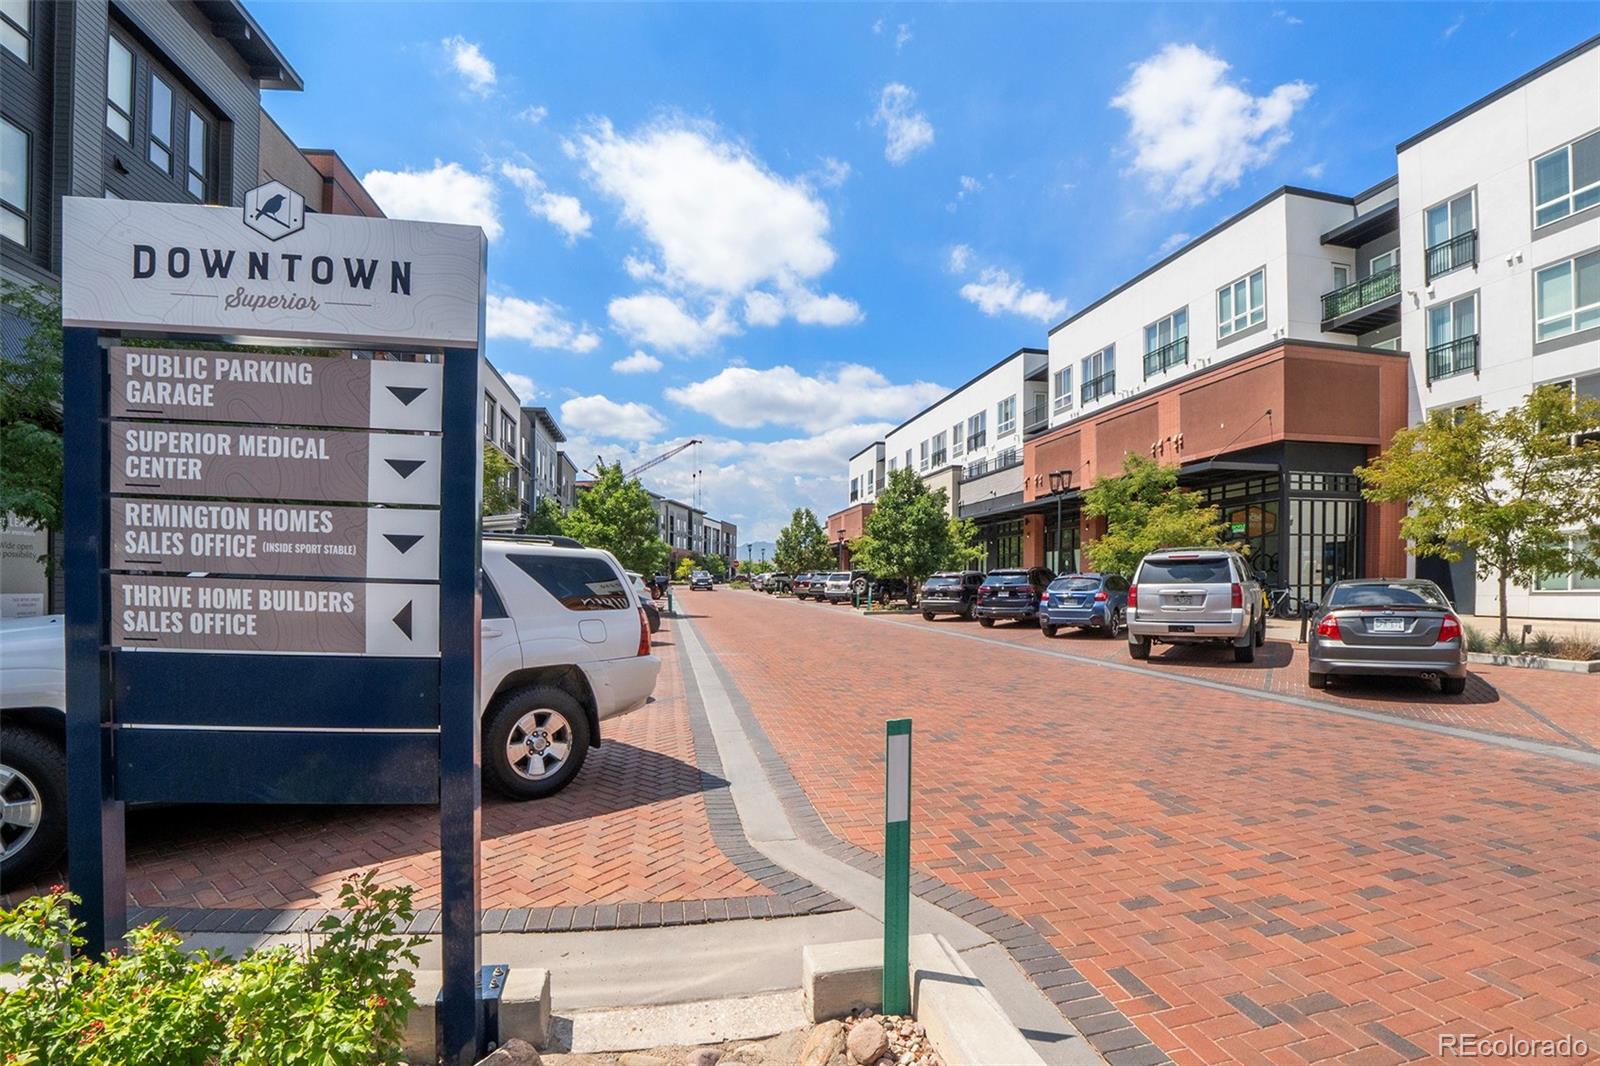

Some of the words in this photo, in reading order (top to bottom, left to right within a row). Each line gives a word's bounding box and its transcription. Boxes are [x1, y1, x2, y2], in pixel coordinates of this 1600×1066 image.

[132, 244, 412, 296] DOWNTOWN
[224, 286, 321, 312] Superior
[125, 352, 208, 381] PUBLIC
[215, 358, 313, 385] PARKING
[125, 380, 214, 407] GARAGE
[125, 430, 231, 455] SUPERIOR
[239, 434, 329, 460] MEDICAL
[125, 456, 202, 480] CENTER
[125, 503, 249, 530] REMINGTON
[257, 508, 333, 533] HOMES
[124, 531, 184, 556] SALES
[190, 533, 257, 558] OFFICE
[262, 541, 293, 554] (INSIDE
[294, 543, 322, 554] SPORT
[323, 544, 357, 556] STABLE)
[122, 584, 192, 608] THRIVE
[198, 587, 253, 610] HOME
[258, 589, 355, 613] BUILDERS
[123, 610, 183, 633] SALES
[190, 613, 257, 636] OFFICE
